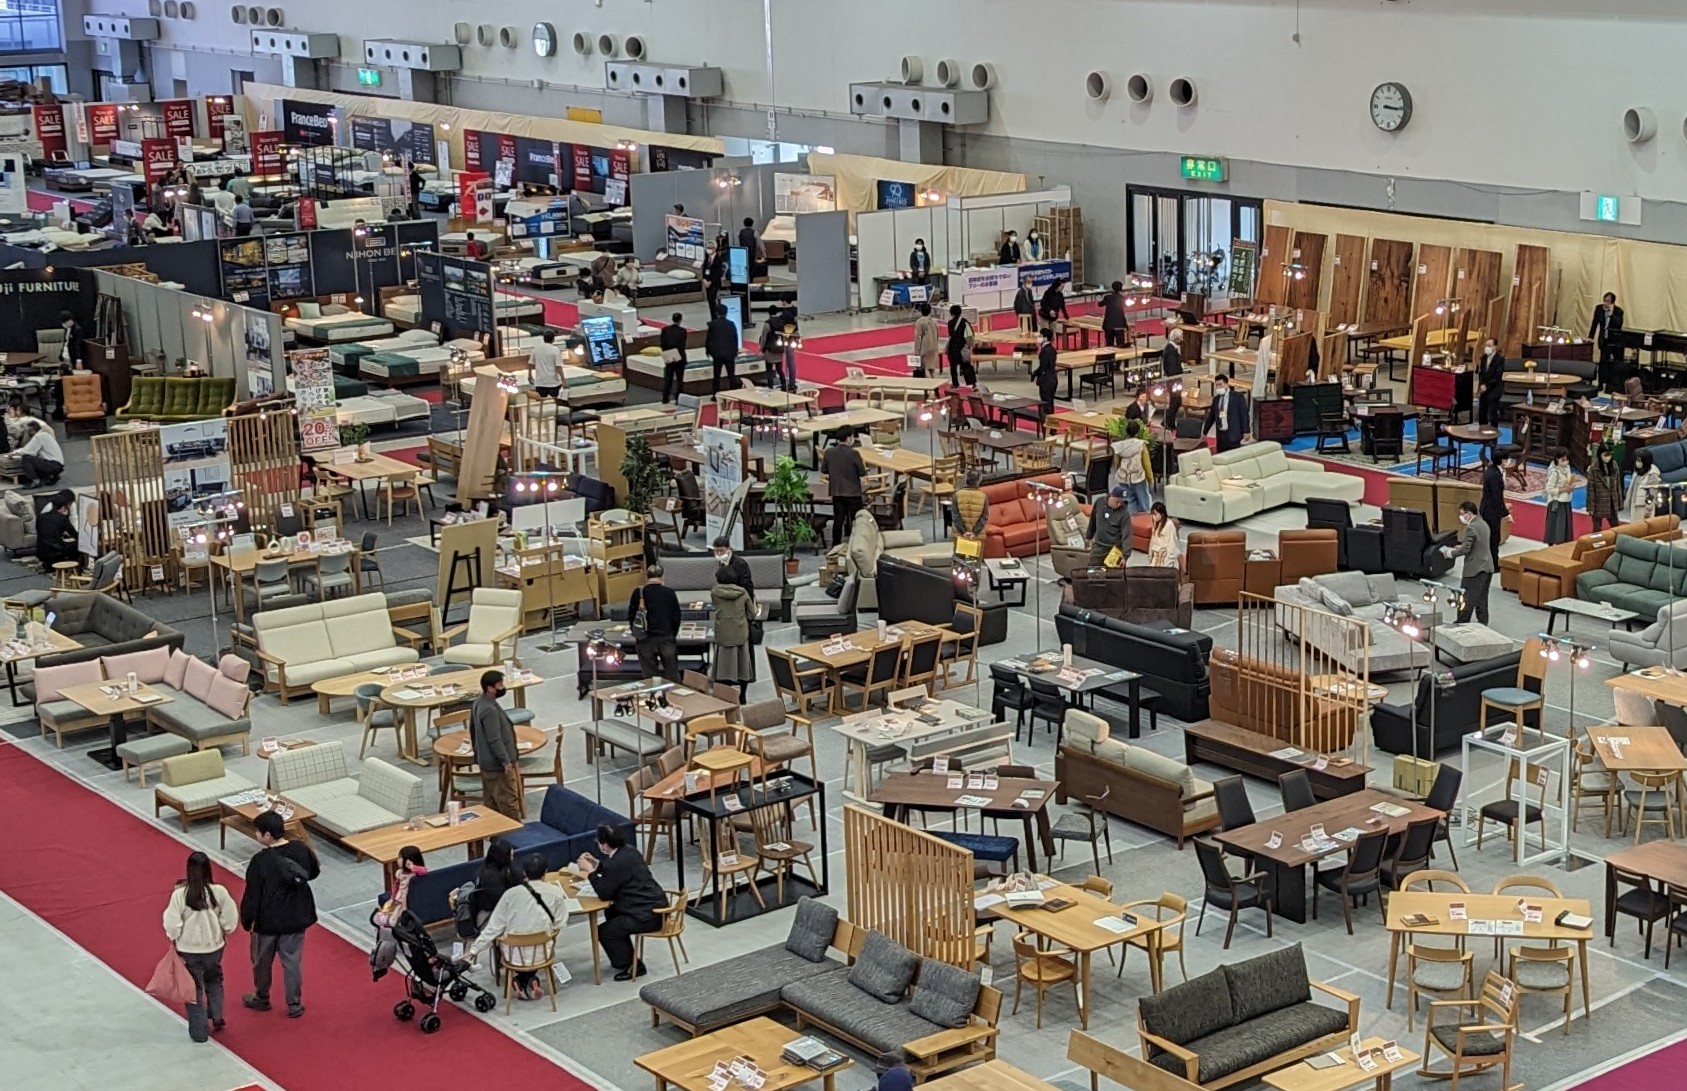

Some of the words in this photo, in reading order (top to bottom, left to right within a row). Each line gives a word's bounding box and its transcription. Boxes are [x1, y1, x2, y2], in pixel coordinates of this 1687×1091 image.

[167, 110, 189, 120] SALE
[210, 105, 231, 115] SALE
[38, 115, 61, 125] SALE
[93, 115, 116, 125] SALE
[256, 144, 280, 154] SALE
[466, 141, 480, 152] SALE
[501, 145, 516, 157] SALE
[148, 150, 174, 162] SALE
[575, 155, 590, 167] SALE
[613, 161, 628, 173] SALE
[1186, 158, 1216, 172] 非常口
[1190, 170, 1211, 178] EXIT
[345, 248, 381, 260] NIHON
[306, 436, 328, 446] OFF
